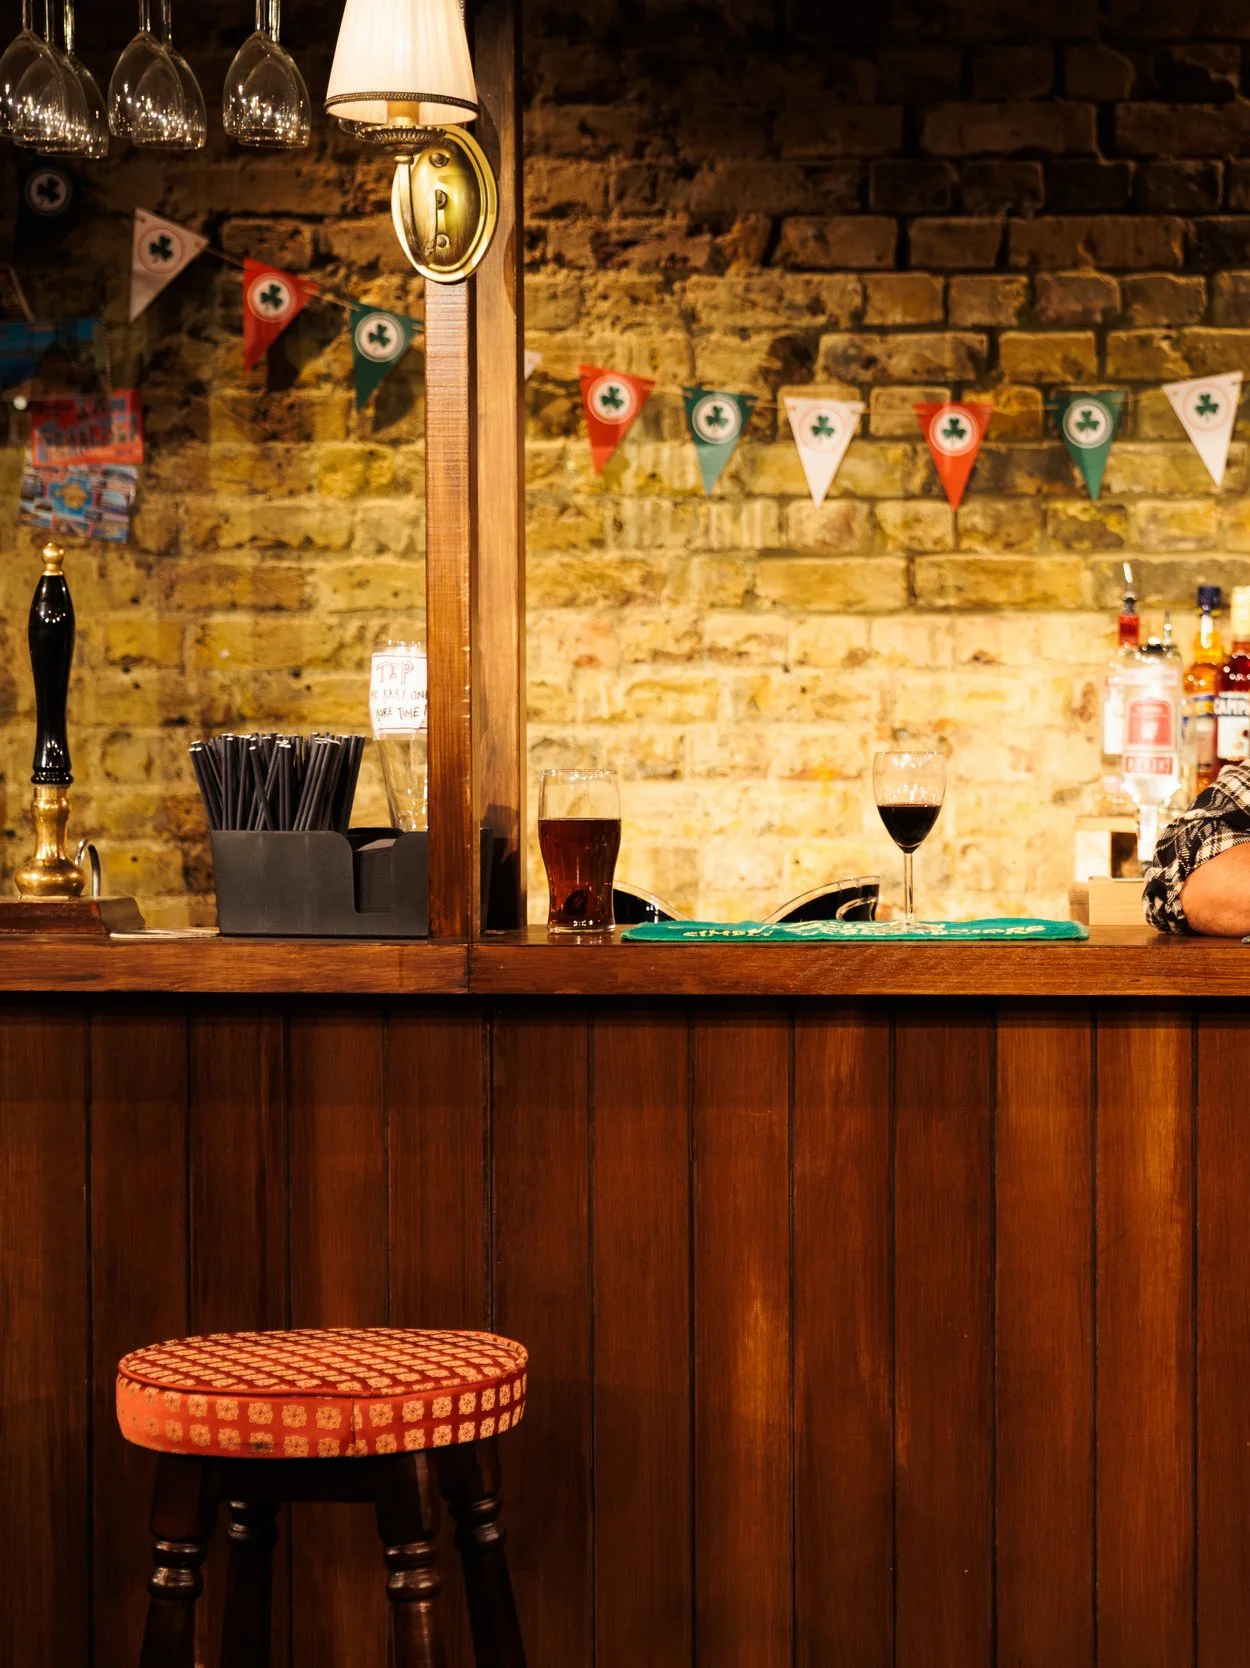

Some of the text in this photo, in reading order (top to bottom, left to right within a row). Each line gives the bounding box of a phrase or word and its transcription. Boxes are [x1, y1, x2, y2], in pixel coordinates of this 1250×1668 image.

[376, 660, 414, 686] TIP
[383, 688, 407, 702] BABY
[1213, 699, 1250, 715] CAMP
